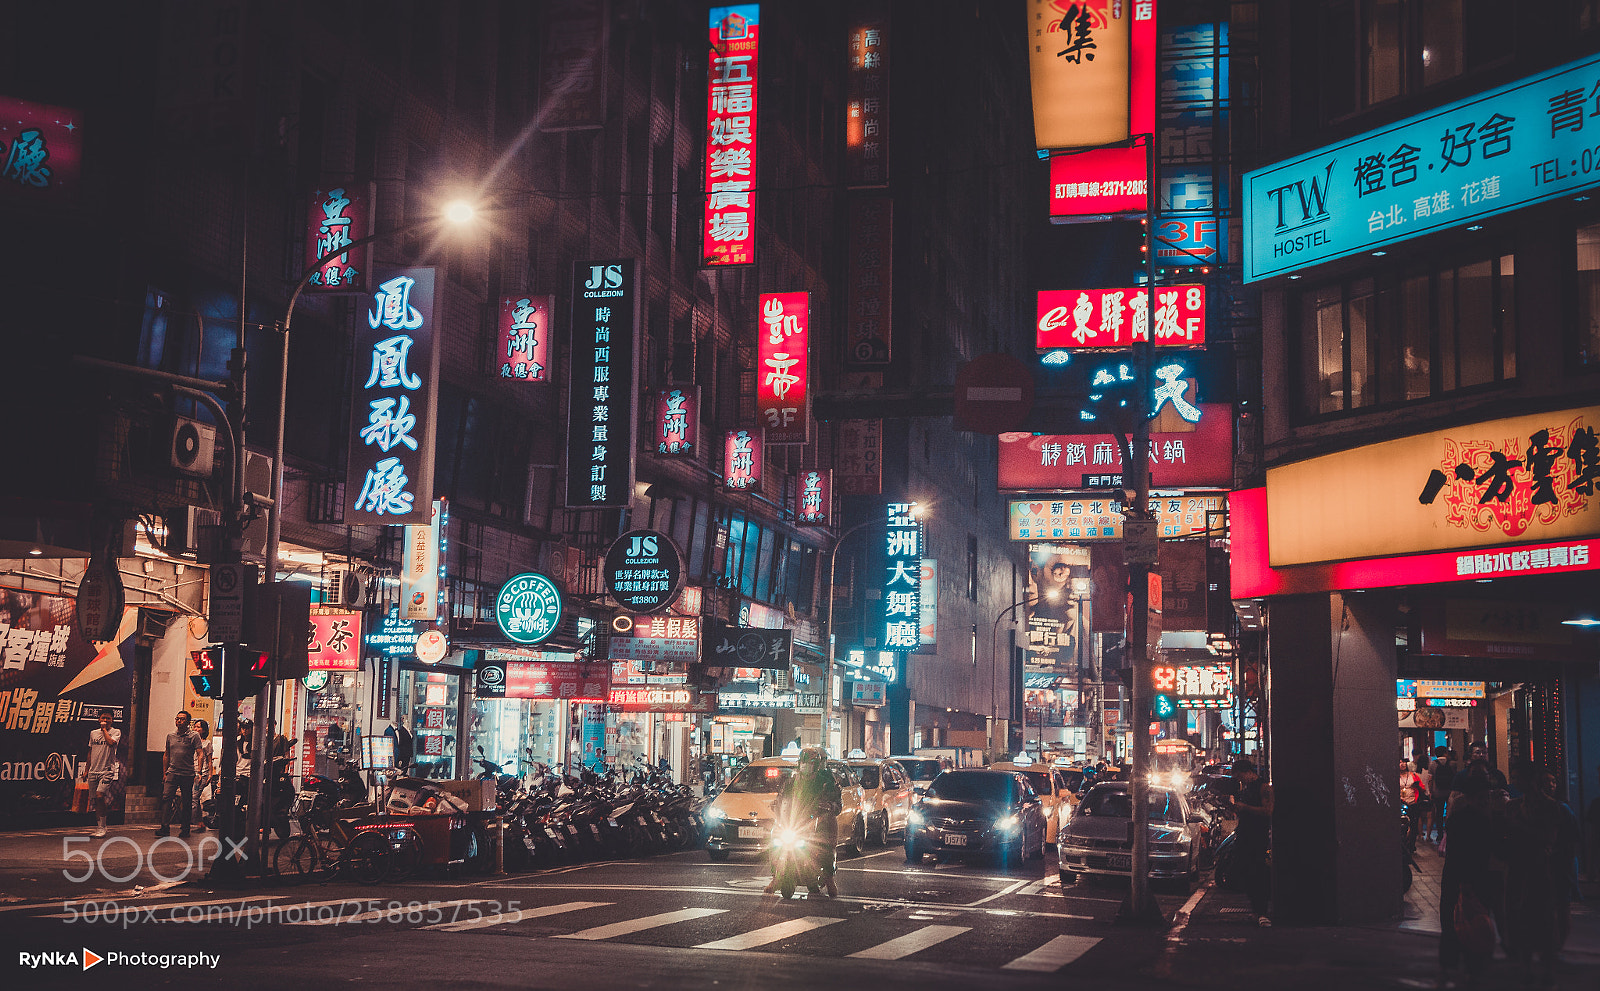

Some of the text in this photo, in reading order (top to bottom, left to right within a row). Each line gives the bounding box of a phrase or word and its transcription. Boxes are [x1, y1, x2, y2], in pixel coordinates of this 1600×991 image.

[728, 41, 757, 51] HOUSE
[1056, 3, 1097, 65] 集
[0, 128, 49, 188] 廳
[708, 55, 753, 243] 五福娛樂廣場
[1267, 157, 1338, 230] TW
[1158, 220, 1220, 243] 3F
[1274, 229, 1332, 258] HOSTEL
[713, 244, 744, 254] 4F
[584, 264, 624, 289] JS
[583, 289, 624, 298] COLLEZIONI
[764, 297, 803, 401] 凱帝
[354, 275, 425, 516] 鳳凰歌廳
[590, 306, 611, 502] 時尚西服專業量身訂製
[764, 407, 798, 428] 3F
[1419, 426, 1600, 505] 八方雲集
[1051, 498, 1218, 515] 新台北電交友 24H
[1164, 525, 1181, 535] 5F
[415, 529, 426, 574] 公益彩券
[625, 535, 659, 558] JS
[1456, 545, 1590, 576] 鍋貼水餃專賣店
[885, 500, 917, 648] 亞洲大舞廳
[635, 617, 697, 639] 一美假髮
[510, 681, 602, 697] 一美假髮
